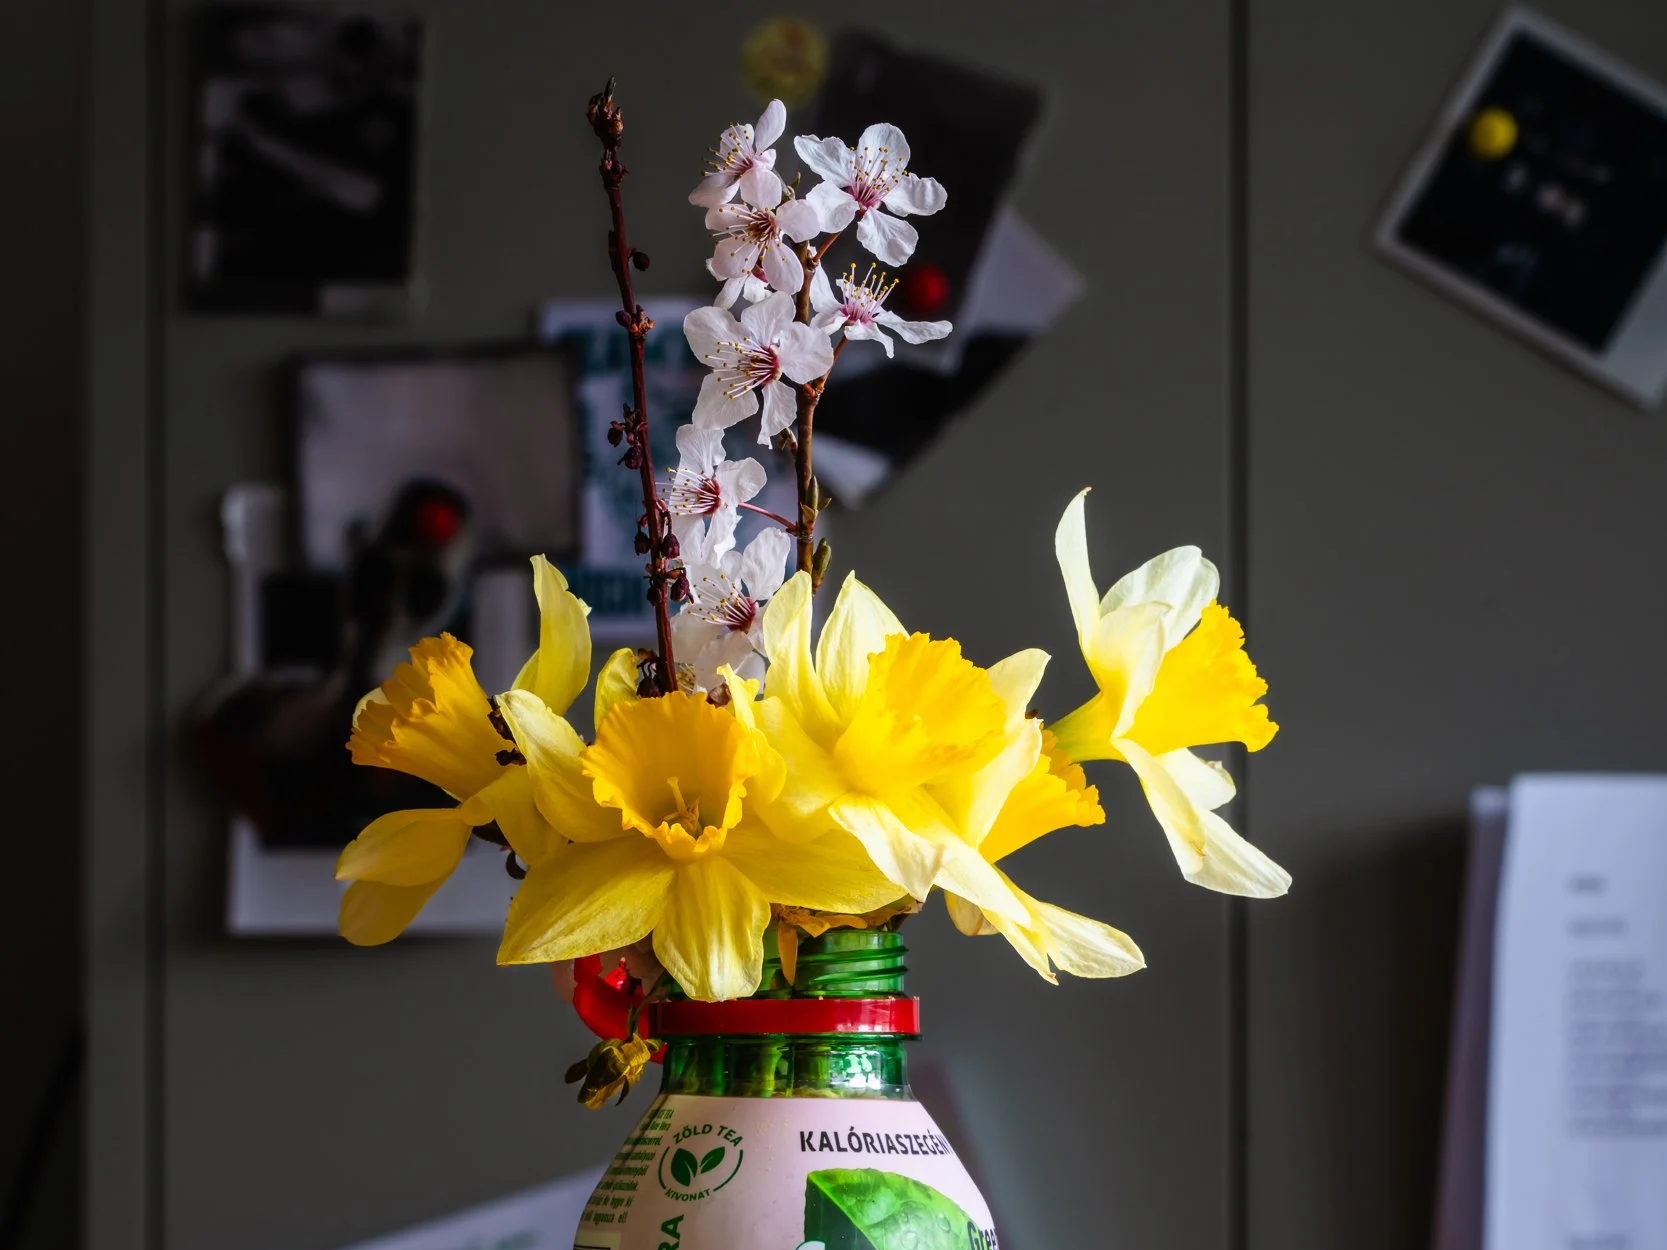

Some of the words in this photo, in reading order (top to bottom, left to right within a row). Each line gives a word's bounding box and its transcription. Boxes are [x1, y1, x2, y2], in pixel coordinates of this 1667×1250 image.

[673, 1124, 712, 1144] ZÖLD
[717, 1125, 743, 1147] TEA
[665, 1188, 710, 1201] KIVONAT
